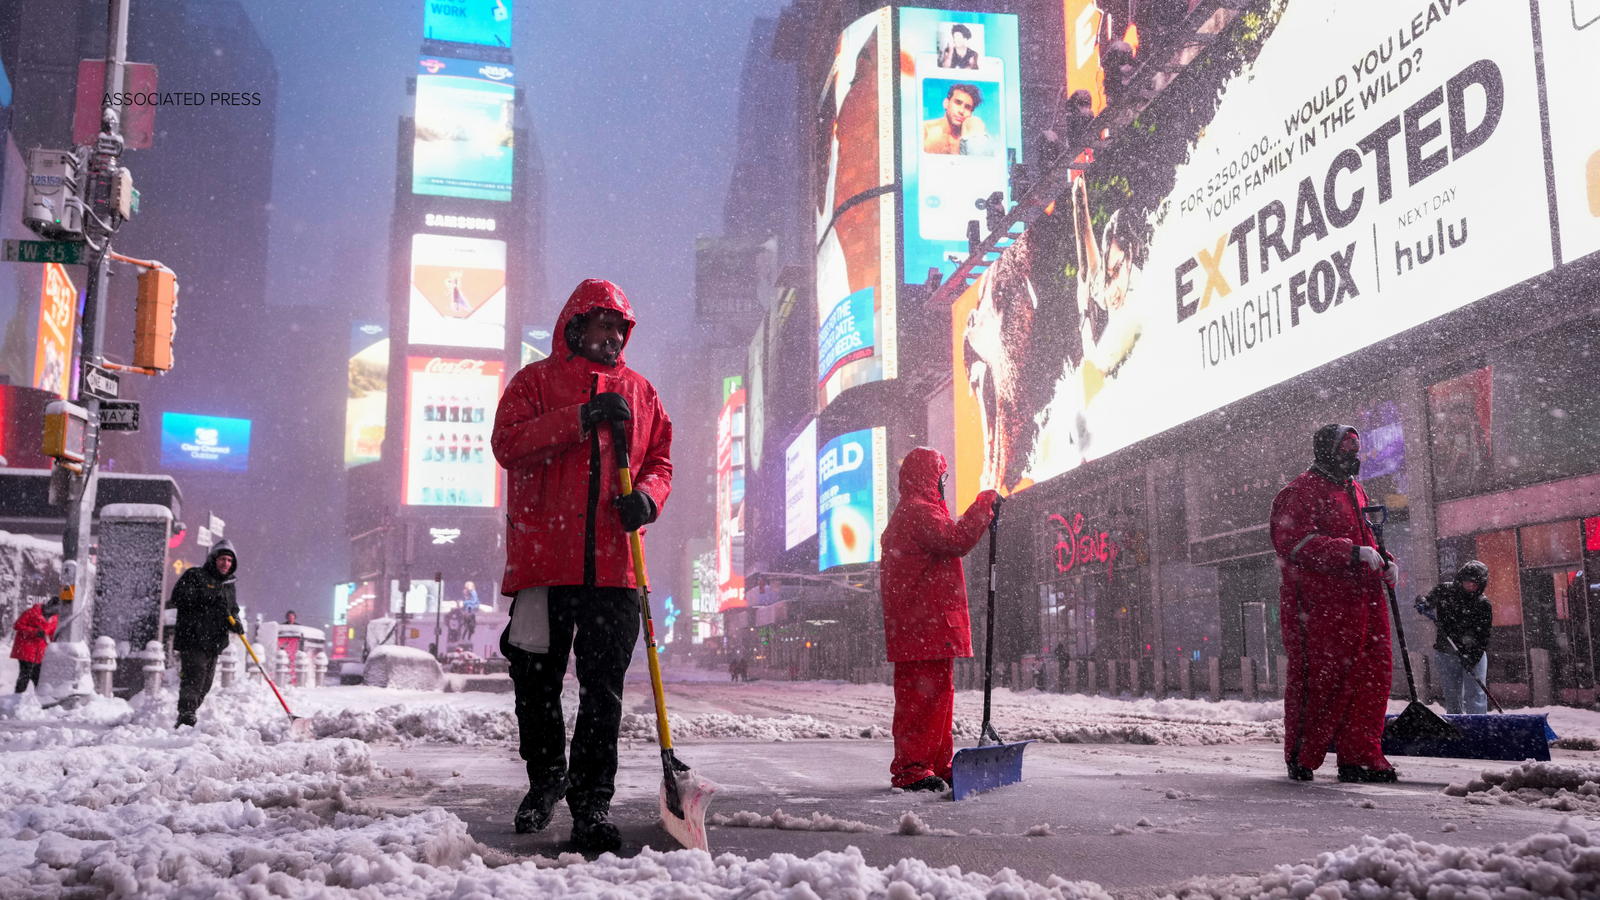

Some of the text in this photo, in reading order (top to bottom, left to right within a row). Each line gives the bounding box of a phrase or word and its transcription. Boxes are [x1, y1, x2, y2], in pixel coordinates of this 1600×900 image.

[431, 4, 467, 18] WORK
[1181, 0, 1468, 217] FOR $250,000... WOULD YOU LEAV
[1206, 48, 1424, 222] YOUR FAMILY IN THE WILD?
[1174, 58, 1505, 325] EXTRACTED
[1398, 186, 1458, 230] NEXT DAY
[425, 213, 496, 231] SAMSUNG
[24, 244, 38, 260] W
[45, 245, 65, 262] 45
[1395, 217, 1469, 276] hulu
[836, 300, 851, 321] THE
[1198, 240, 1361, 370] TONIGHT FOX
[105, 379, 117, 393] WAY
[819, 442, 864, 485] FEELD
